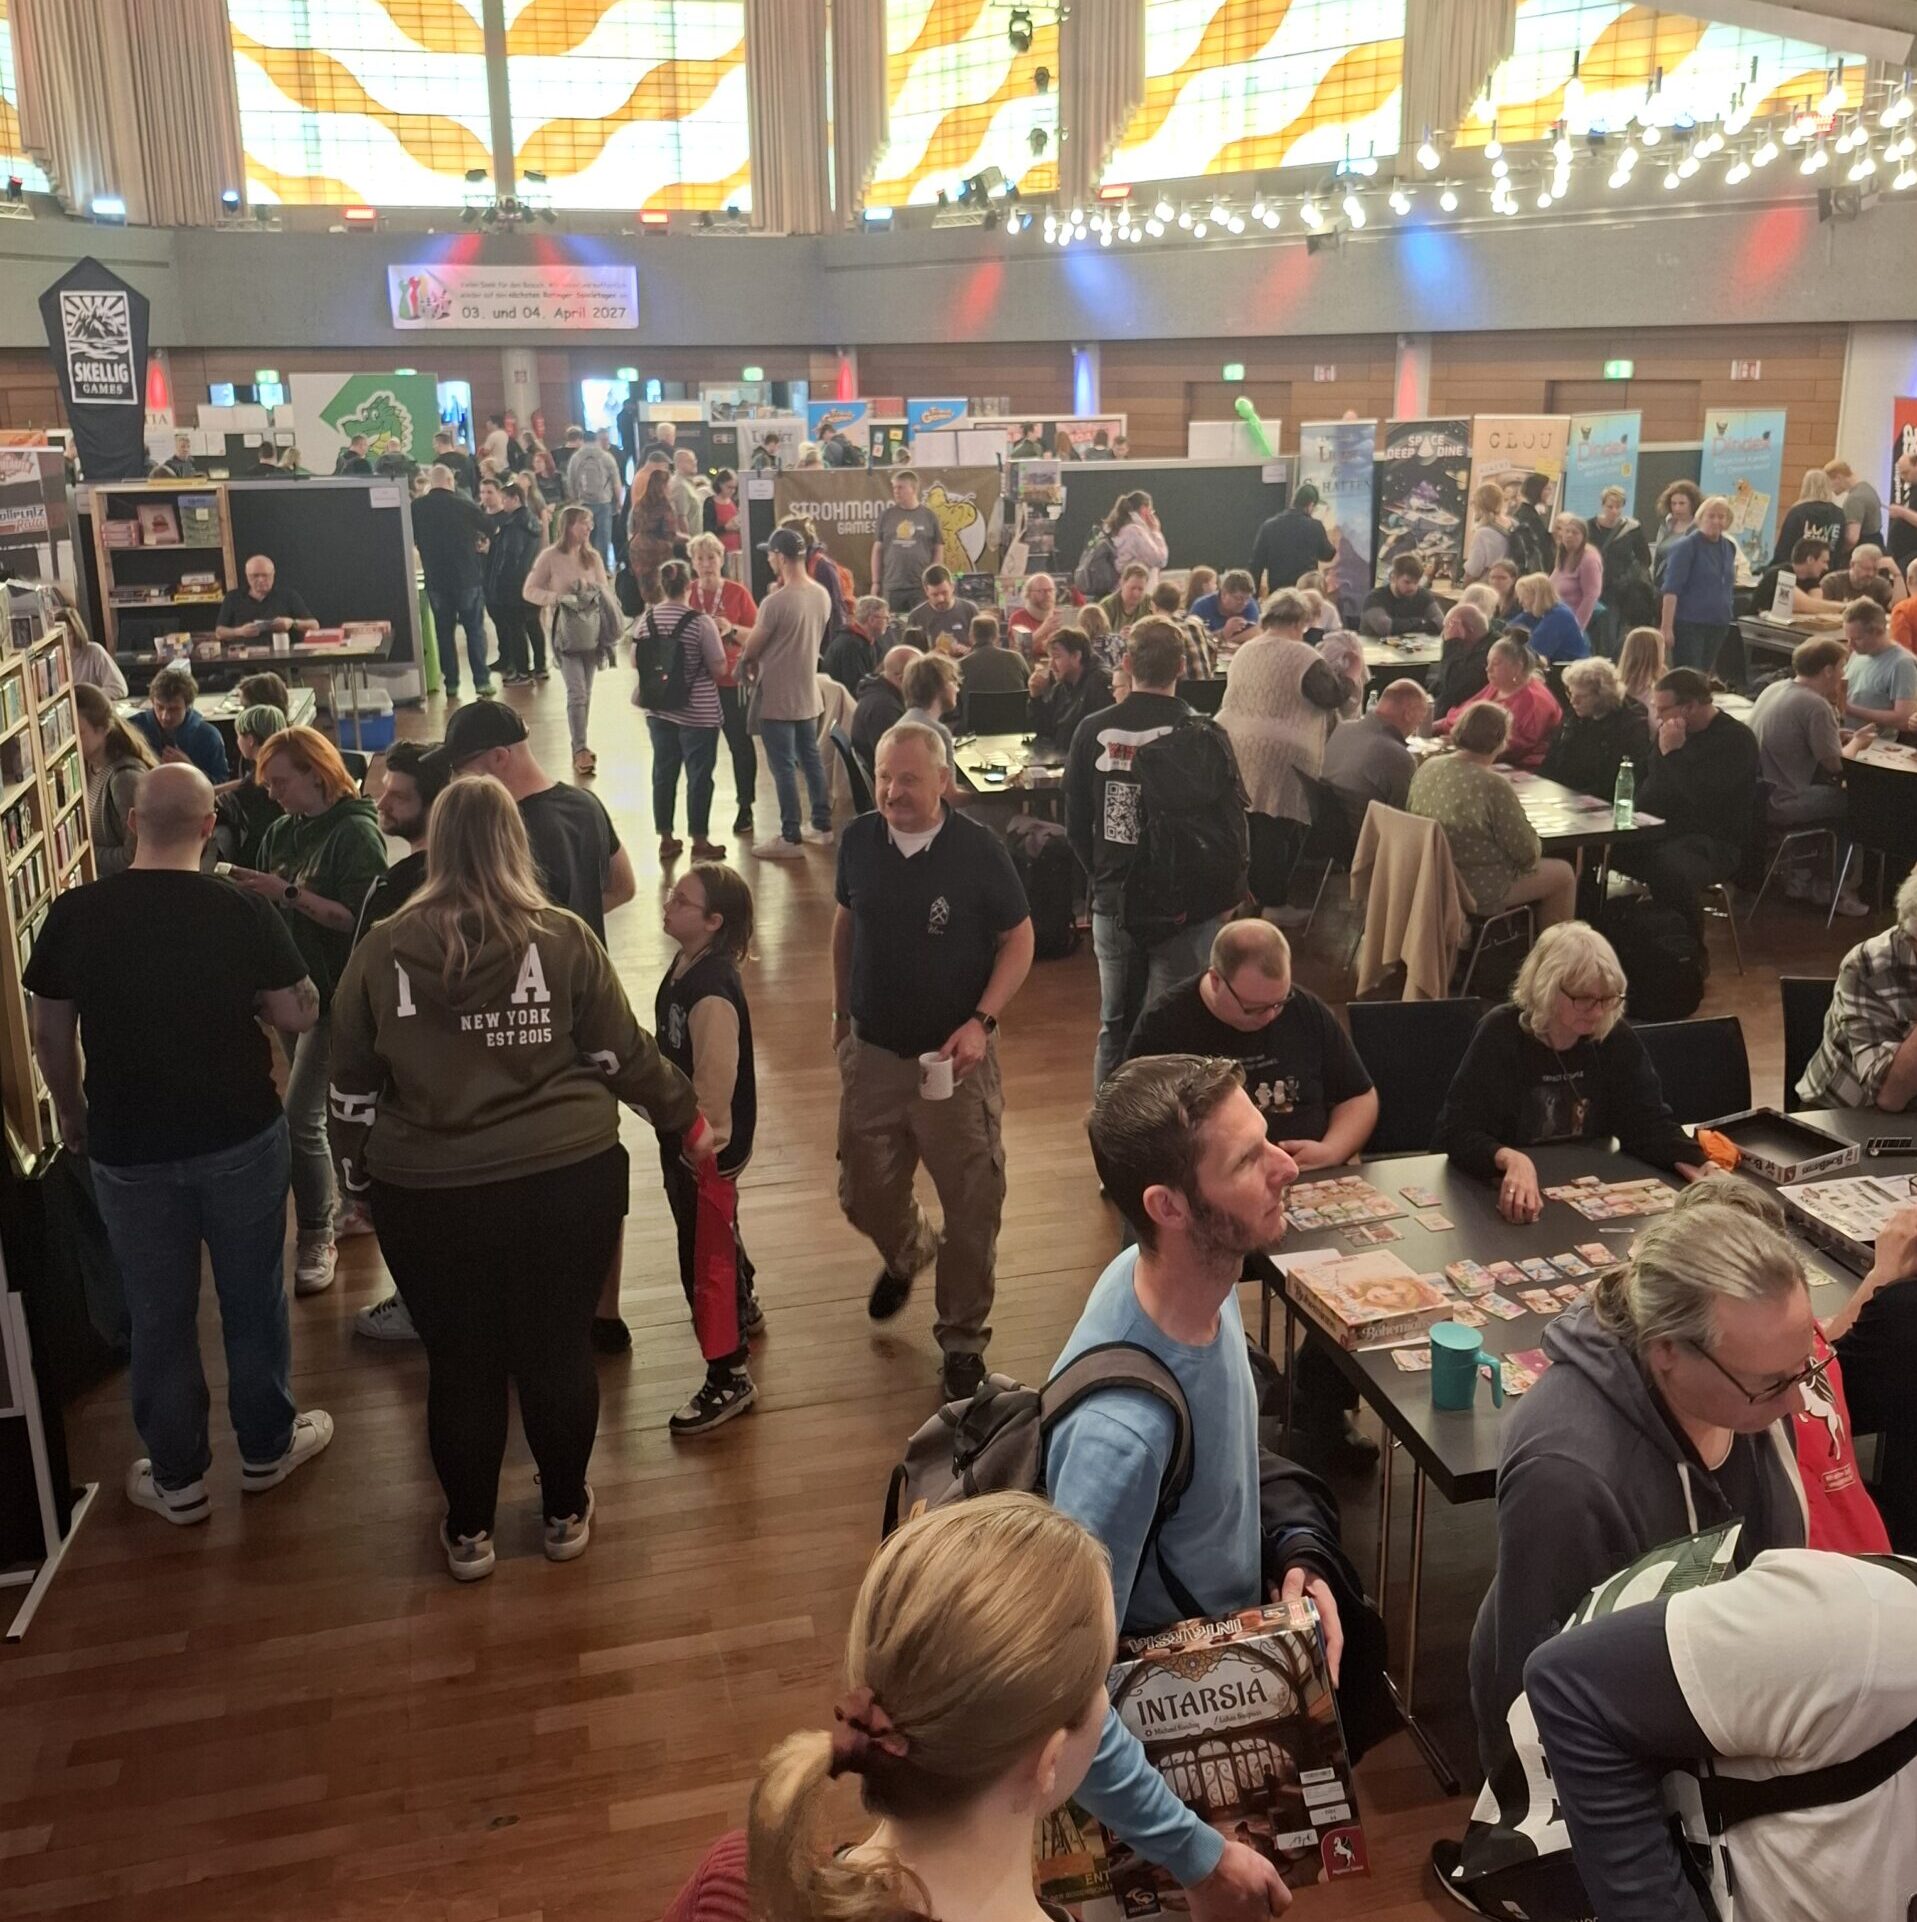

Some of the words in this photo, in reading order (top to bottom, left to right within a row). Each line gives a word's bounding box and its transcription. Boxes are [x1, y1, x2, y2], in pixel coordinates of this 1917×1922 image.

[461, 306, 486, 320] 03.
[493, 306, 517, 320] und
[522, 306, 547, 320] 04.
[553, 306, 587, 323] April
[592, 305, 627, 320] 2027
[75, 362, 130, 383] SKELLIG
[82, 383, 124, 395] GAMES
[1386, 447, 1416, 461] DEEP
[1436, 446, 1465, 458] DINE
[460, 1011, 501, 1032] NEW
[506, 1008, 551, 1026] YORK
[486, 1031, 515, 1048] EST
[518, 1027, 552, 1045] 2015
[1128, 1619, 1243, 1653] INTARSIA
[1136, 1677, 1269, 1727] INTARSIA
